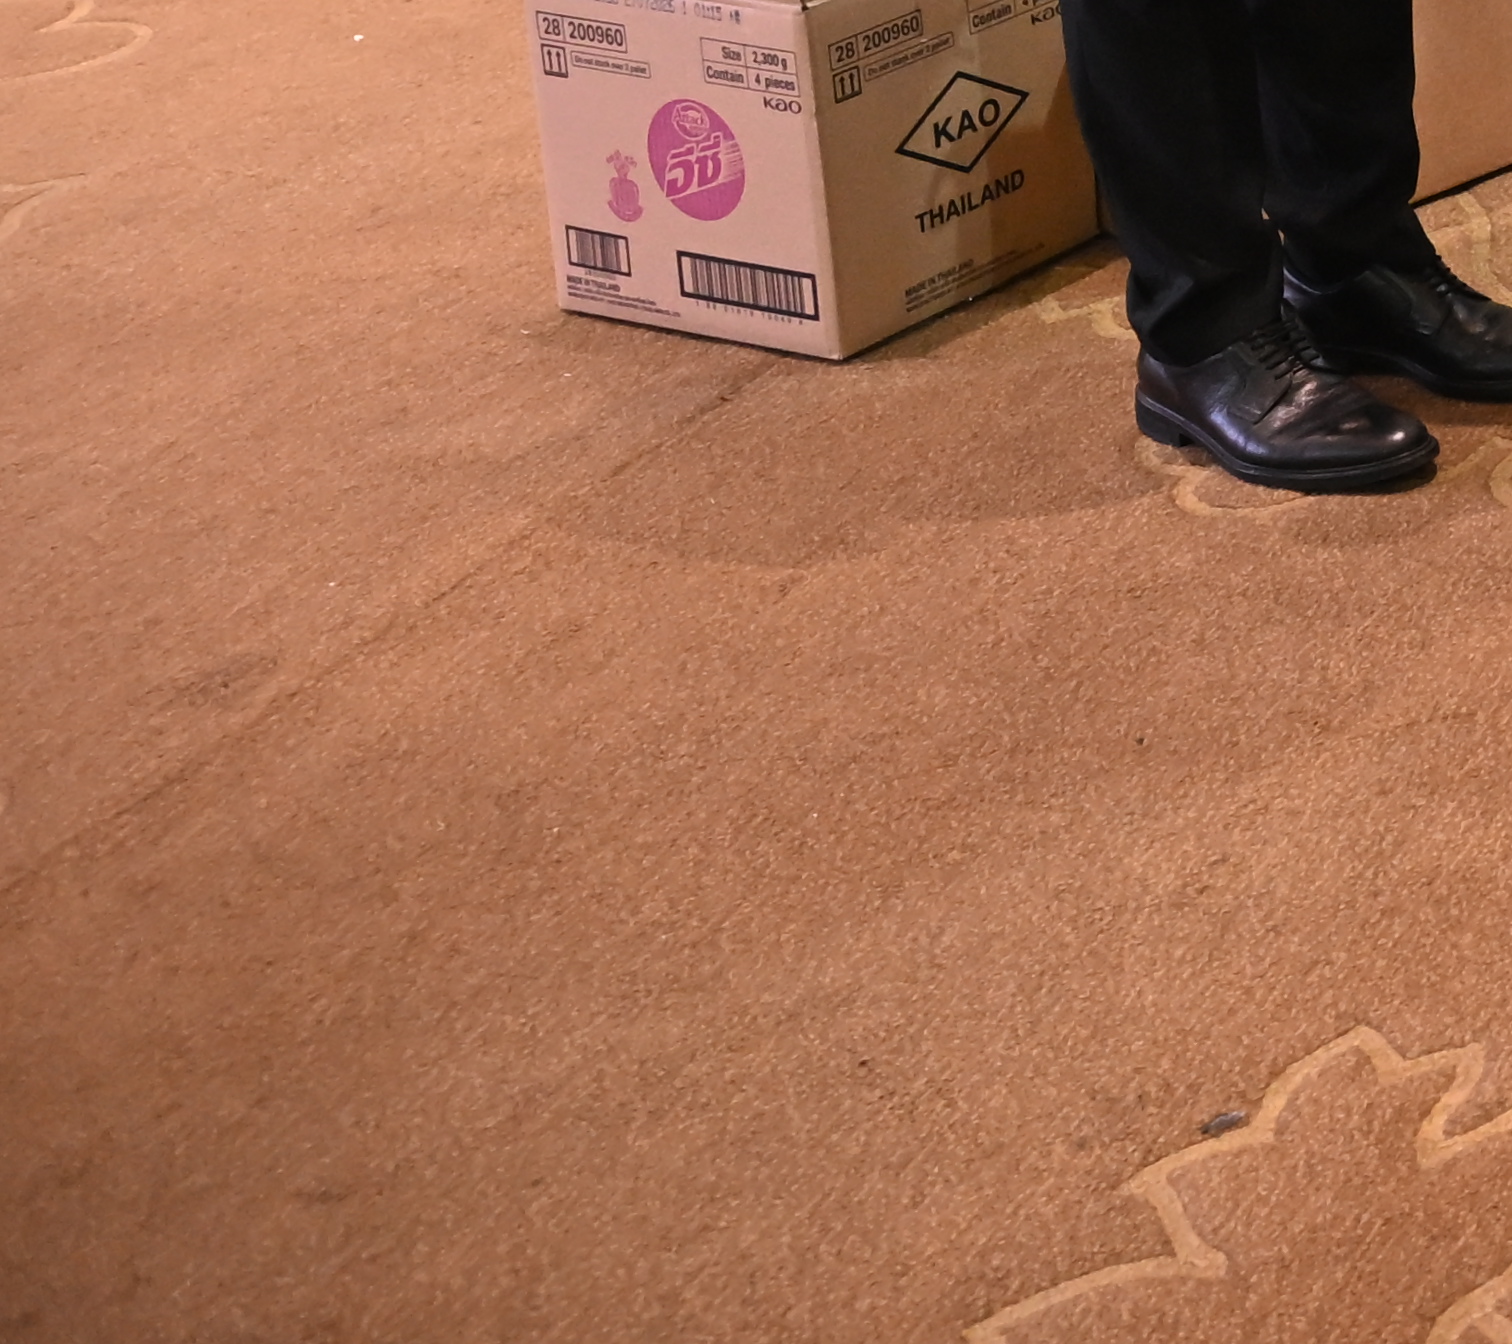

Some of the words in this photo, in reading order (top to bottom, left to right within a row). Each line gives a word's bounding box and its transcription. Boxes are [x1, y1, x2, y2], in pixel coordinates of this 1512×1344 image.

[972, 3, 1012, 28] Contain
[542, 16, 561, 37] 28
[568, 21, 624, 47] 200960
[835, 41, 856, 64] 28
[862, 14, 920, 53] 200960
[721, 46, 742, 62] Size
[752, 51, 780, 68] 2,300
[780, 58, 788, 71] g
[706, 66, 744, 85] Contain
[754, 73, 761, 86] 4
[765, 75, 795, 92] pieces
[763, 96, 802, 115] kao
[933, 98, 1001, 149] KAO
[914, 169, 1026, 234] THAILAND
